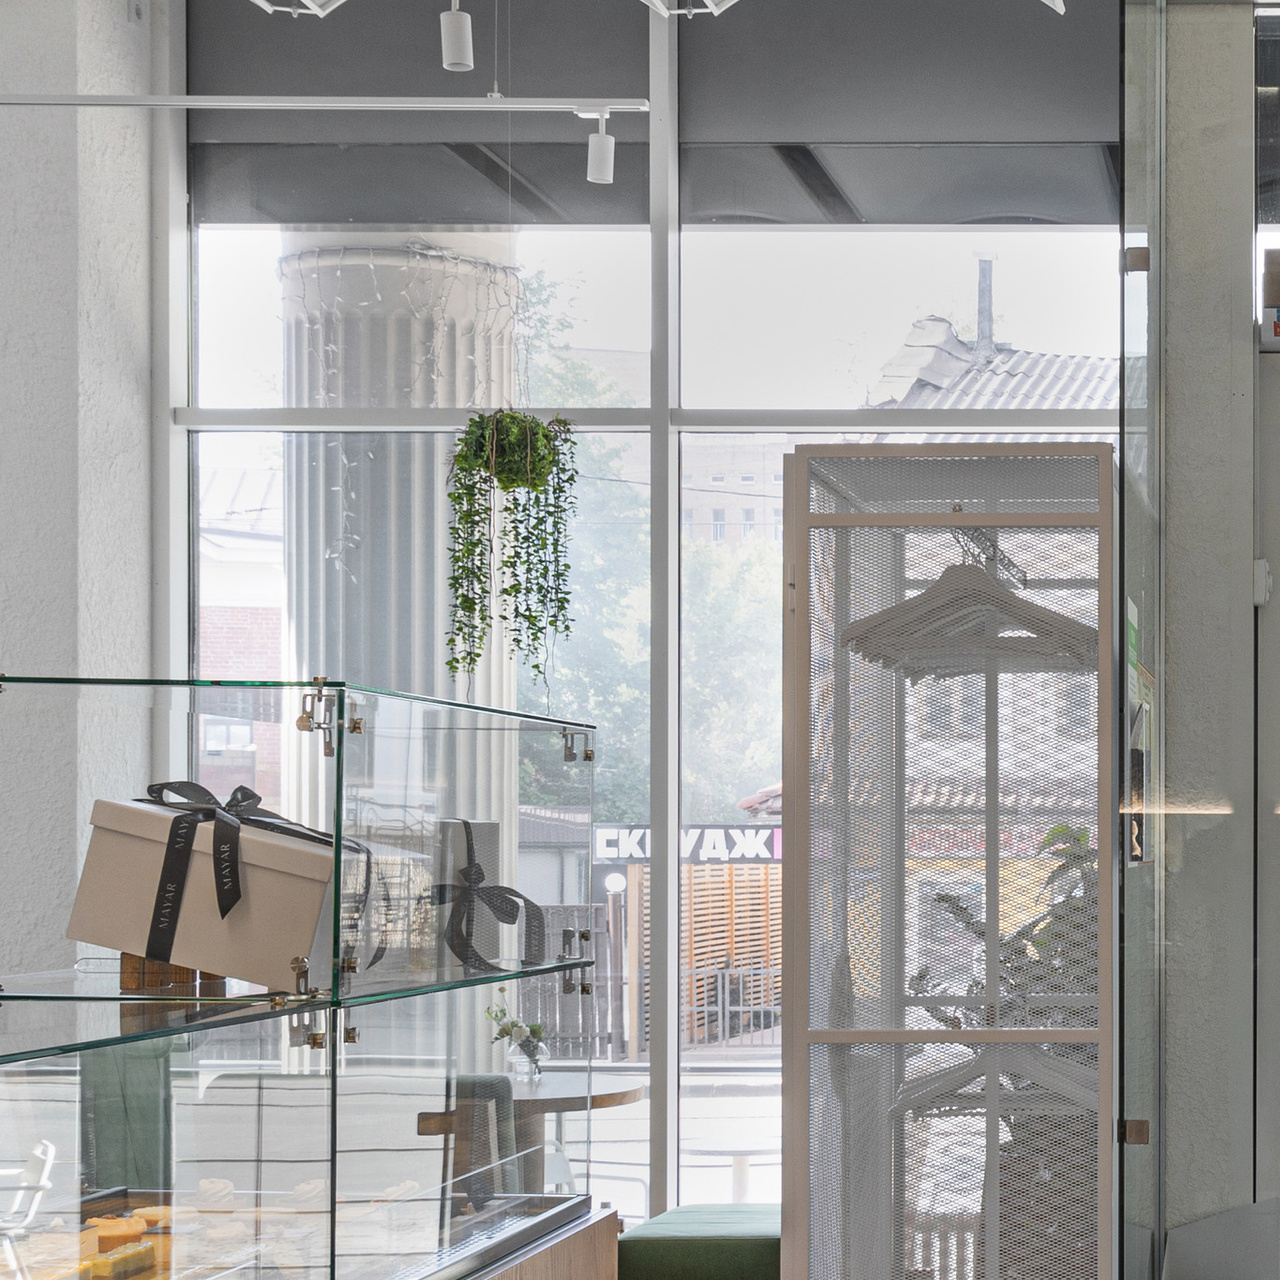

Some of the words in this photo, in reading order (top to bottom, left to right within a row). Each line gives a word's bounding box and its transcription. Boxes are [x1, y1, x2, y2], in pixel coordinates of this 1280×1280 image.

[217, 843, 234, 890] MAYÁR
[596, 828, 772, 861] СКУДЖ
[159, 883, 177, 929] MAYÁR
